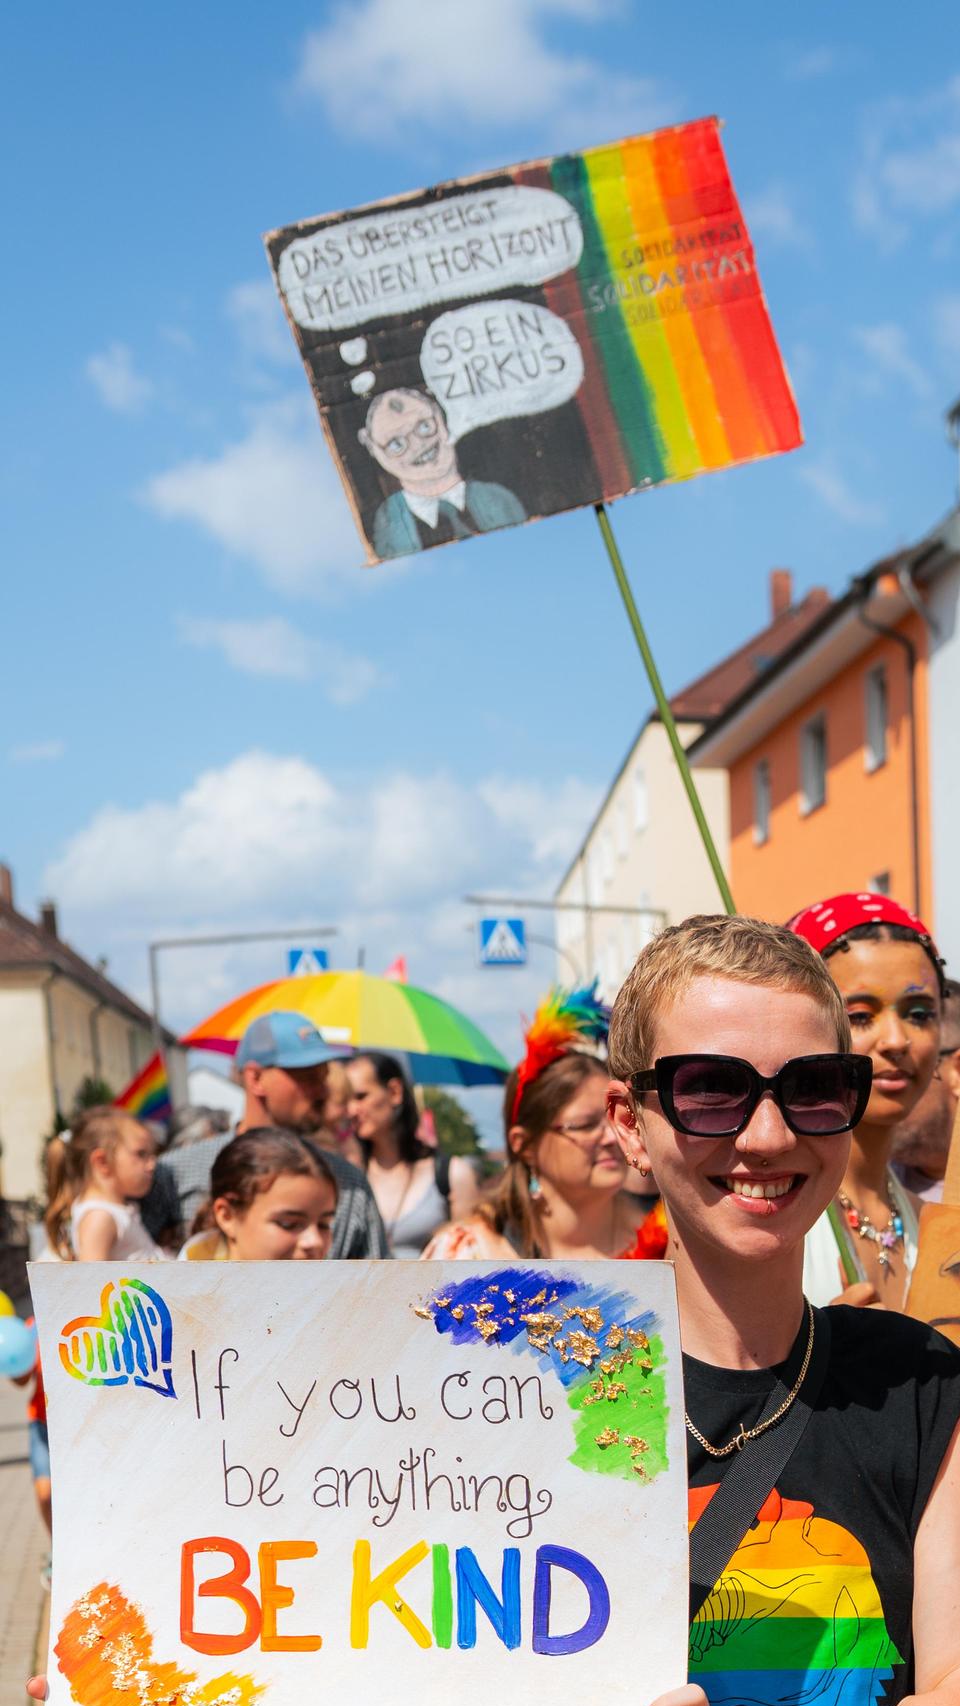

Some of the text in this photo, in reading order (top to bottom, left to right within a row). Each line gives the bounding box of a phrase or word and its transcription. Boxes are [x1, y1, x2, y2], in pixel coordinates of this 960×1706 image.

[291, 199, 497, 280] DAS ÜBERSTEIGT
[303, 217, 575, 320] MEINEN HORIZONT
[587, 249, 752, 313] SOLIDARITÄT
[429, 342, 566, 399] ZIRKUS
[430, 309, 544, 364] SO EIN
[191, 1348, 554, 1438] If you can
[222, 1439, 554, 1539] be anything
[180, 1536, 610, 1656] BE KIND
